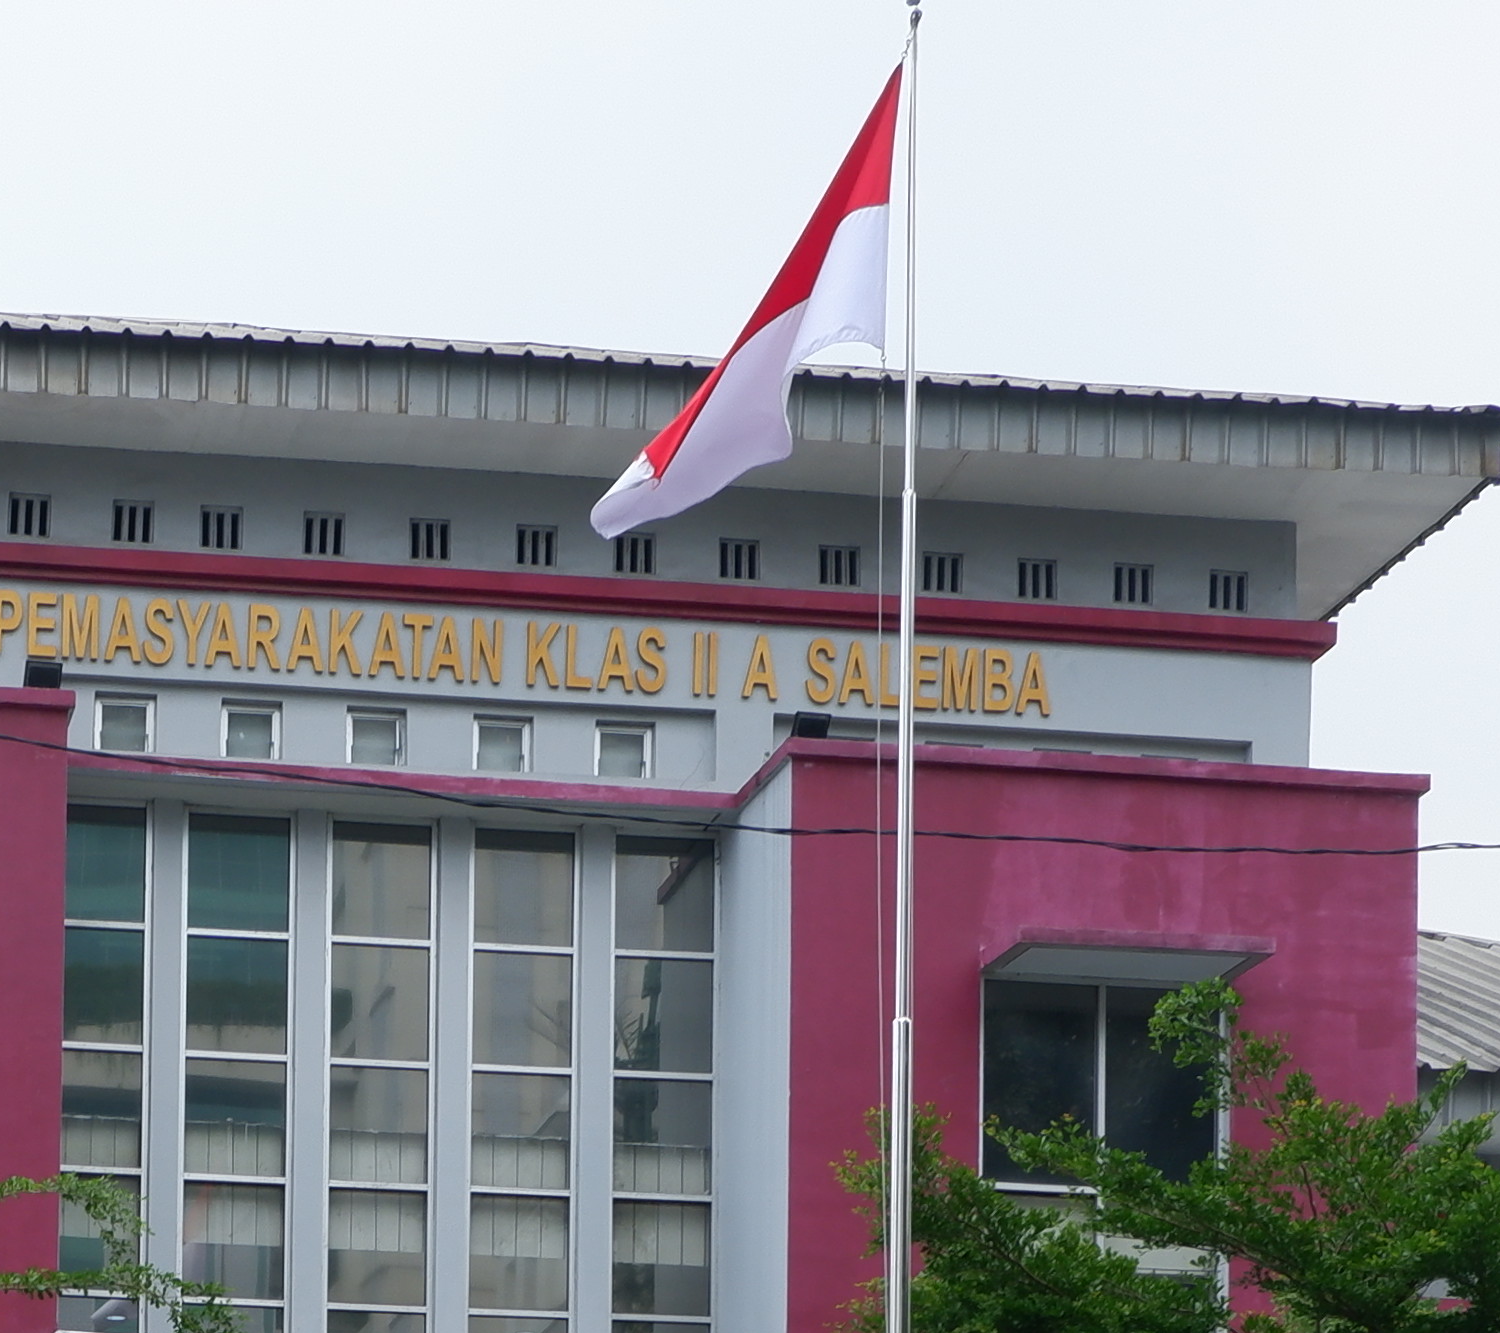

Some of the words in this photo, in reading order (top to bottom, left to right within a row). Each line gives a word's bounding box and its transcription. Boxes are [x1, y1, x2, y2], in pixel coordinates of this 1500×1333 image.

[526, 621, 666, 693] KLAS
[693, 631, 717, 697] II
[742, 635, 778, 700] A
[806, 638, 1051, 716] SALEMBA
